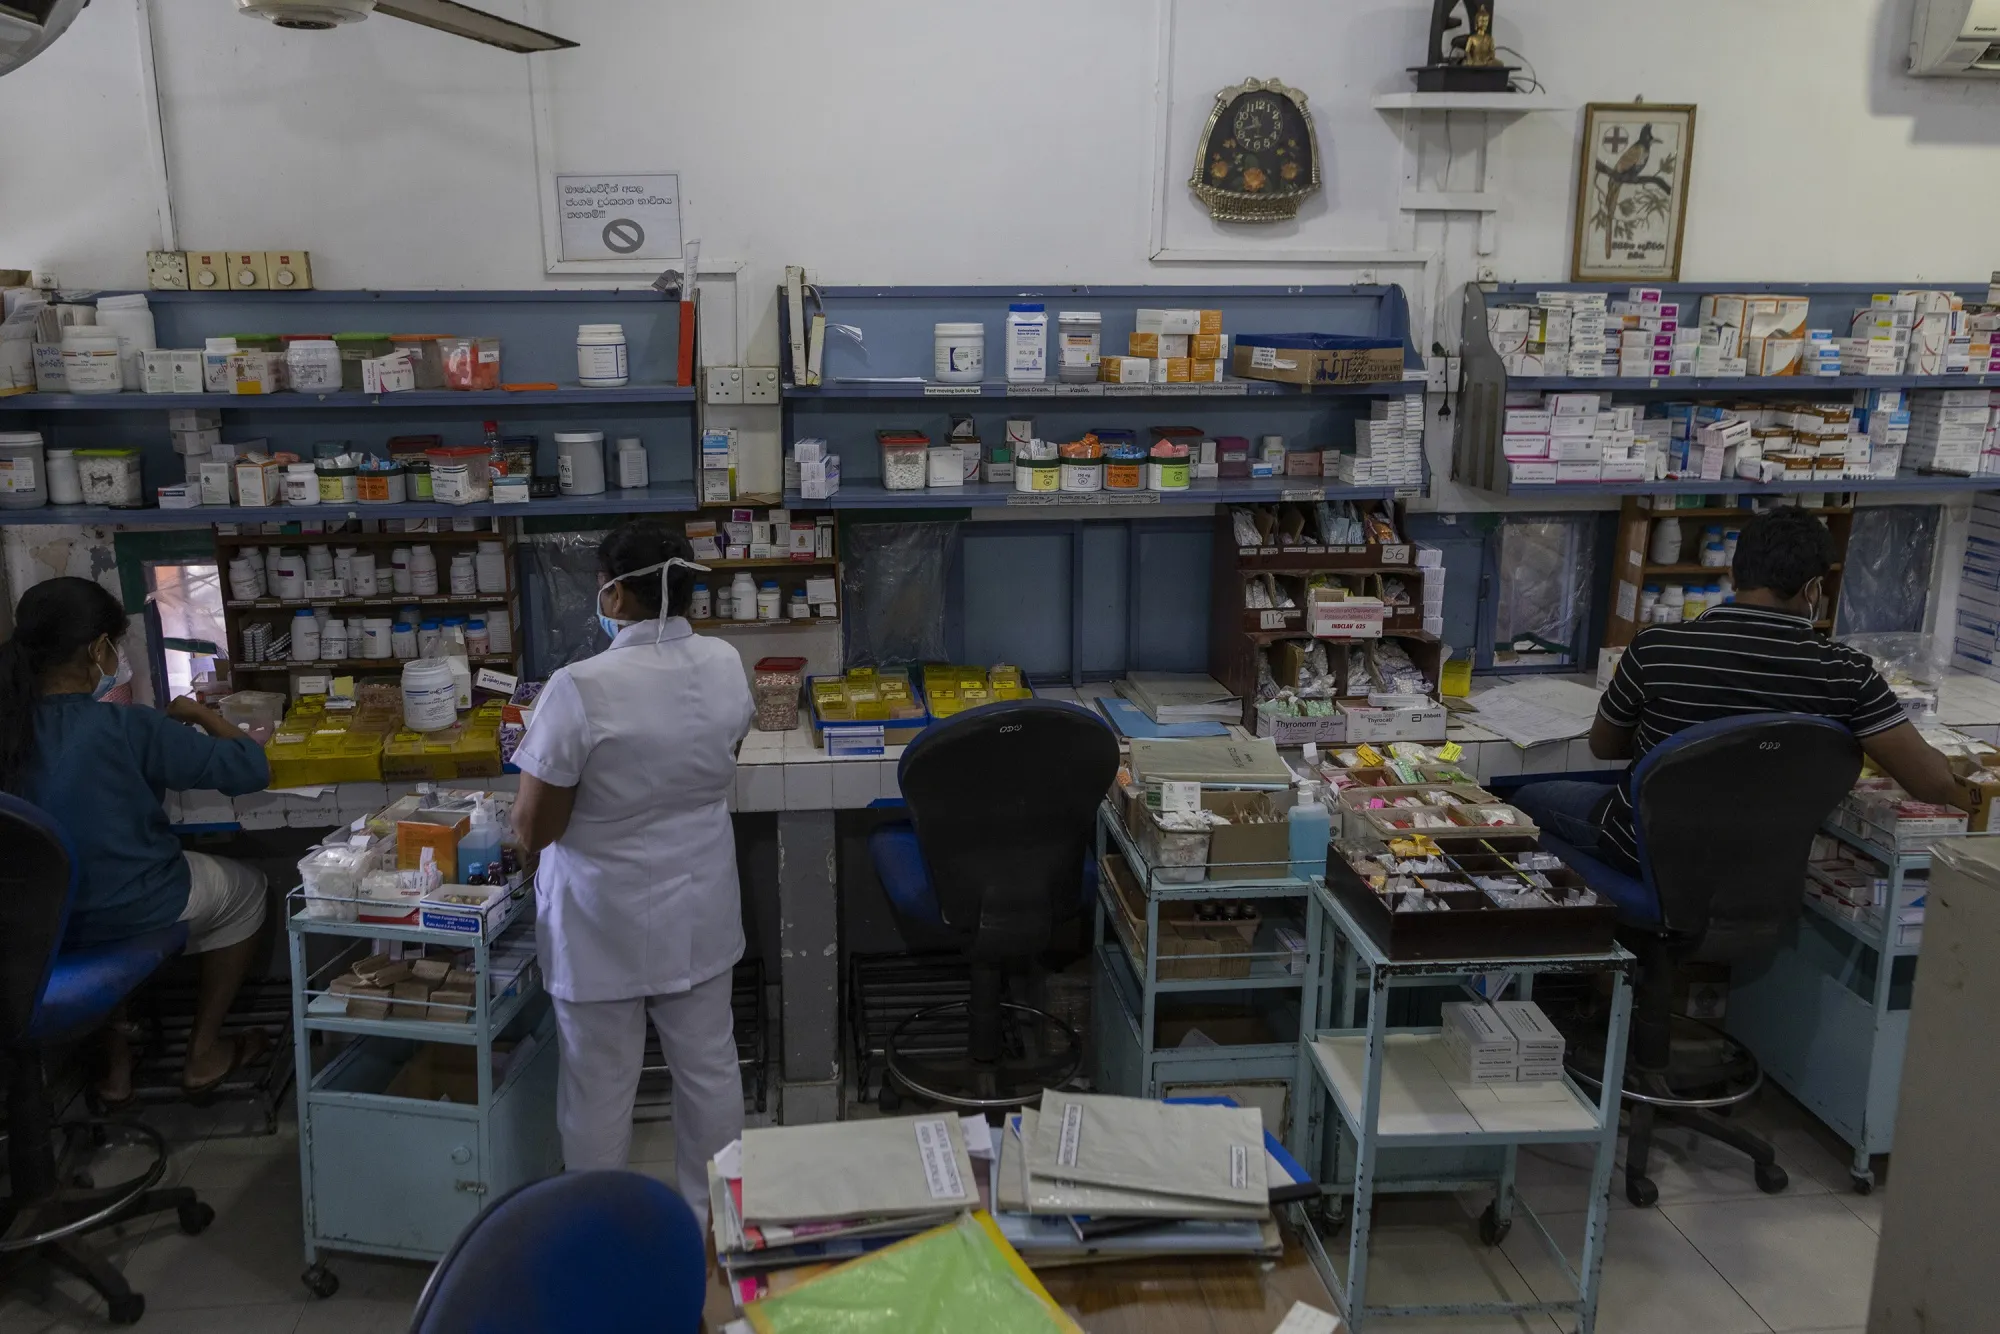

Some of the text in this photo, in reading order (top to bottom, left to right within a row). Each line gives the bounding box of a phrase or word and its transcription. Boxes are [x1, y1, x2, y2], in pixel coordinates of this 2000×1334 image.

[1255, 100, 1265, 110] 12
[1266, 103, 1271, 113] 1
[1240, 111, 1249, 121] 10
[1272, 110, 1279, 120] 2
[1236, 120, 1244, 130] 9
[1274, 121, 1281, 130] 3
[1238, 130, 1246, 140] 8
[1270, 131, 1277, 140] 4
[1244, 138, 1251, 148] 7
[1253, 140, 1261, 151] 6
[1383, 548, 1405, 560] 56
[1265, 612, 1284, 625] 112
[1276, 720, 1316, 729] Thyronorm
